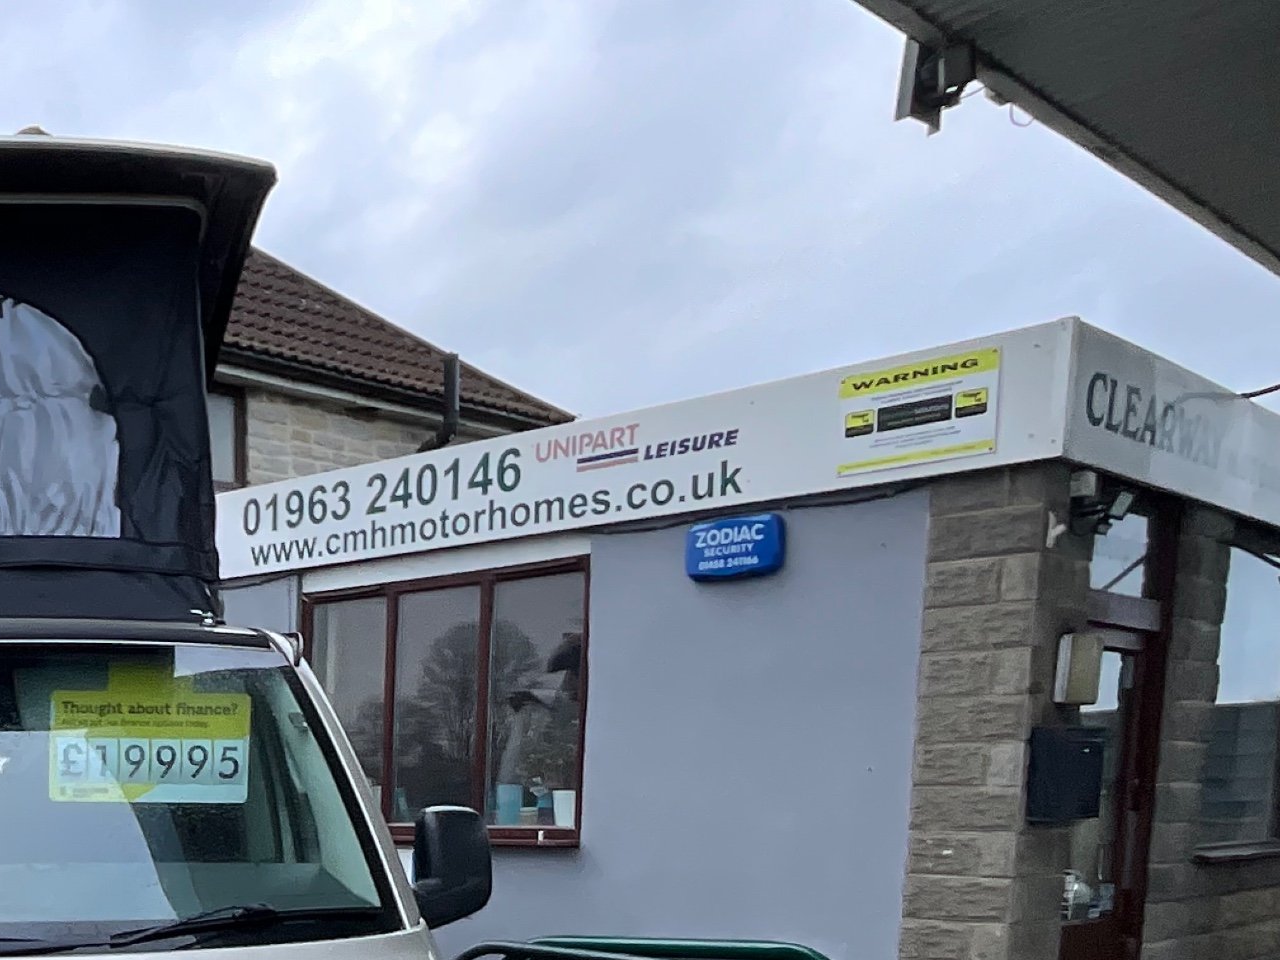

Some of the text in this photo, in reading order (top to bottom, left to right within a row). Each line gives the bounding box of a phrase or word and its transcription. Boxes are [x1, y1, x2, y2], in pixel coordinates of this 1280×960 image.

[852, 358, 979, 391] WARNING
[534, 423, 641, 464] UNIPART
[643, 428, 740, 461] LEISURE
[242, 447, 522, 537] 01963 240146
[250, 459, 743, 567] www.cmhmotorhomes.co.uk
[695, 523, 766, 548] ZODIAC
[703, 542, 756, 558] SECURITY
[61, 701, 239, 717] Thought about finance?
[60, 742, 240, 780] £19995
